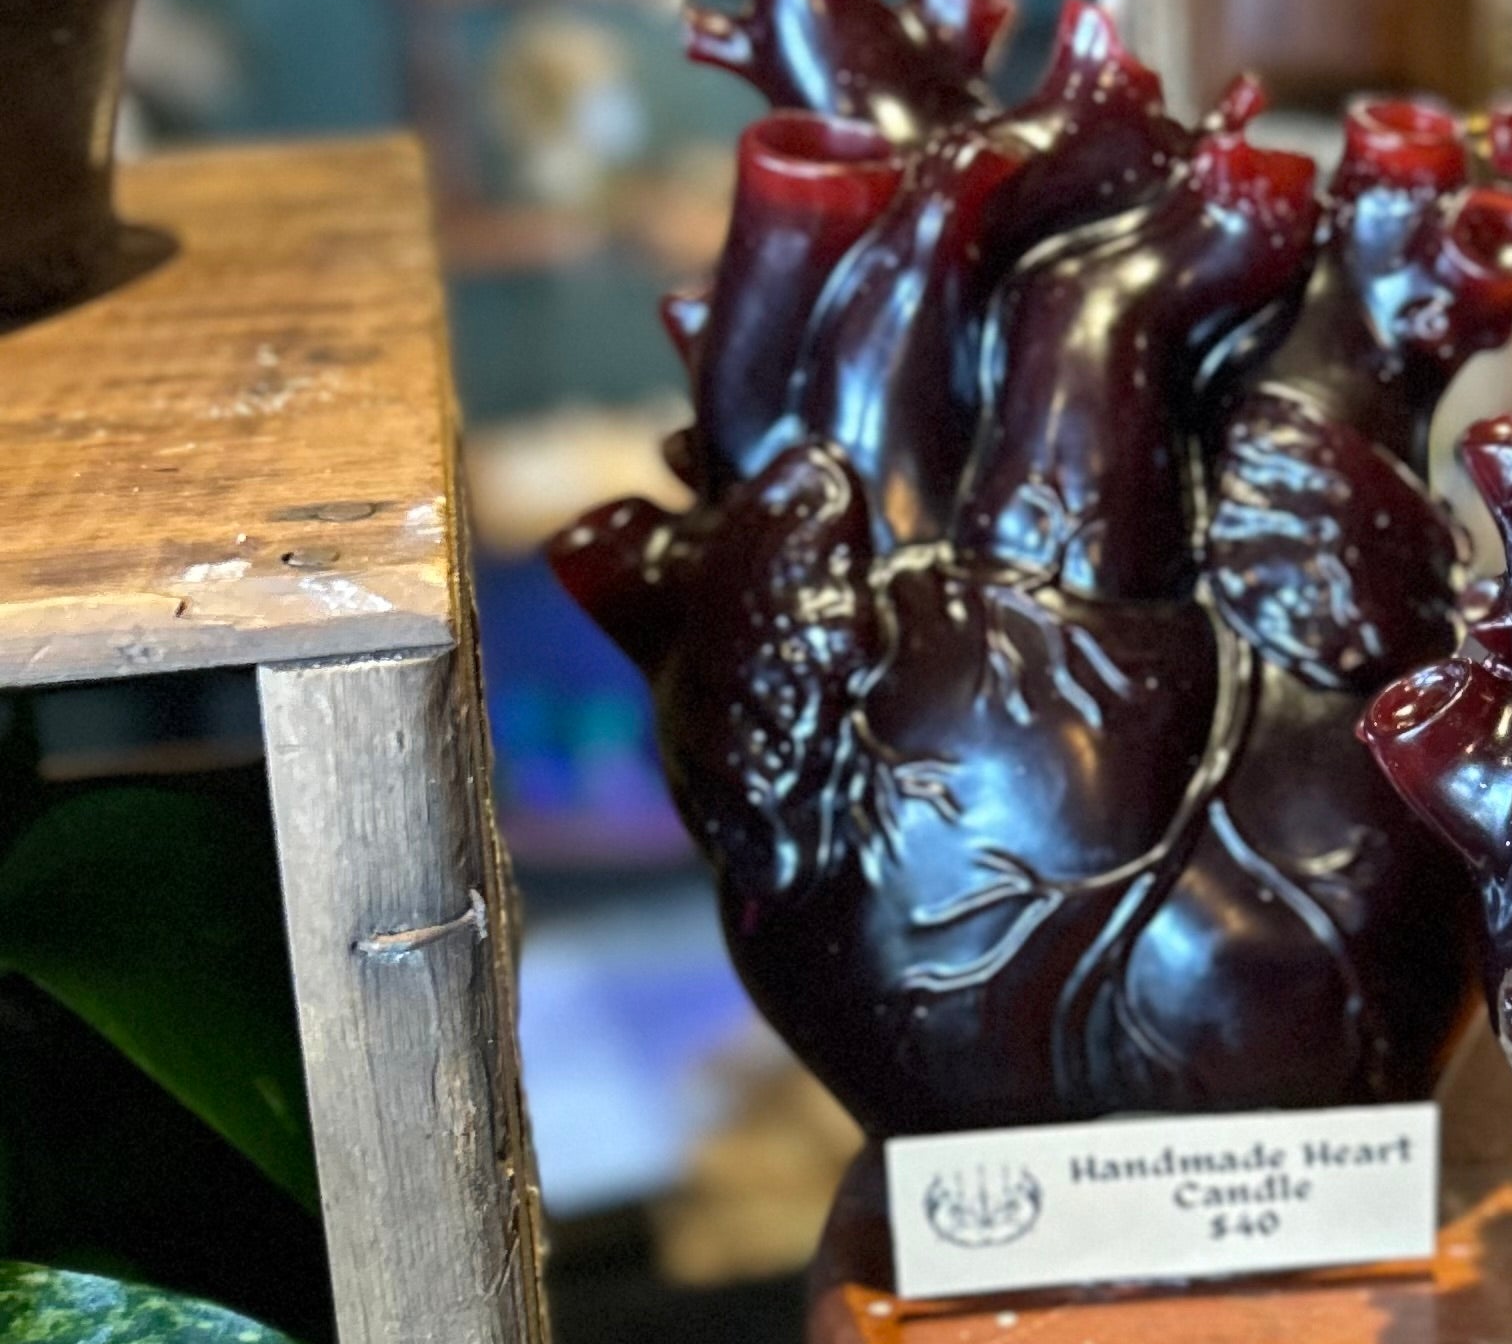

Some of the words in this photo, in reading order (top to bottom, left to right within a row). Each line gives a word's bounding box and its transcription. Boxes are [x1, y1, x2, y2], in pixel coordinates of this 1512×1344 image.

[1071, 1142, 1286, 1183] Handmade
[1303, 1135, 1412, 1168] Heart
[1173, 1175, 1312, 1209] Candle
[1209, 1210, 1281, 1240] $40
